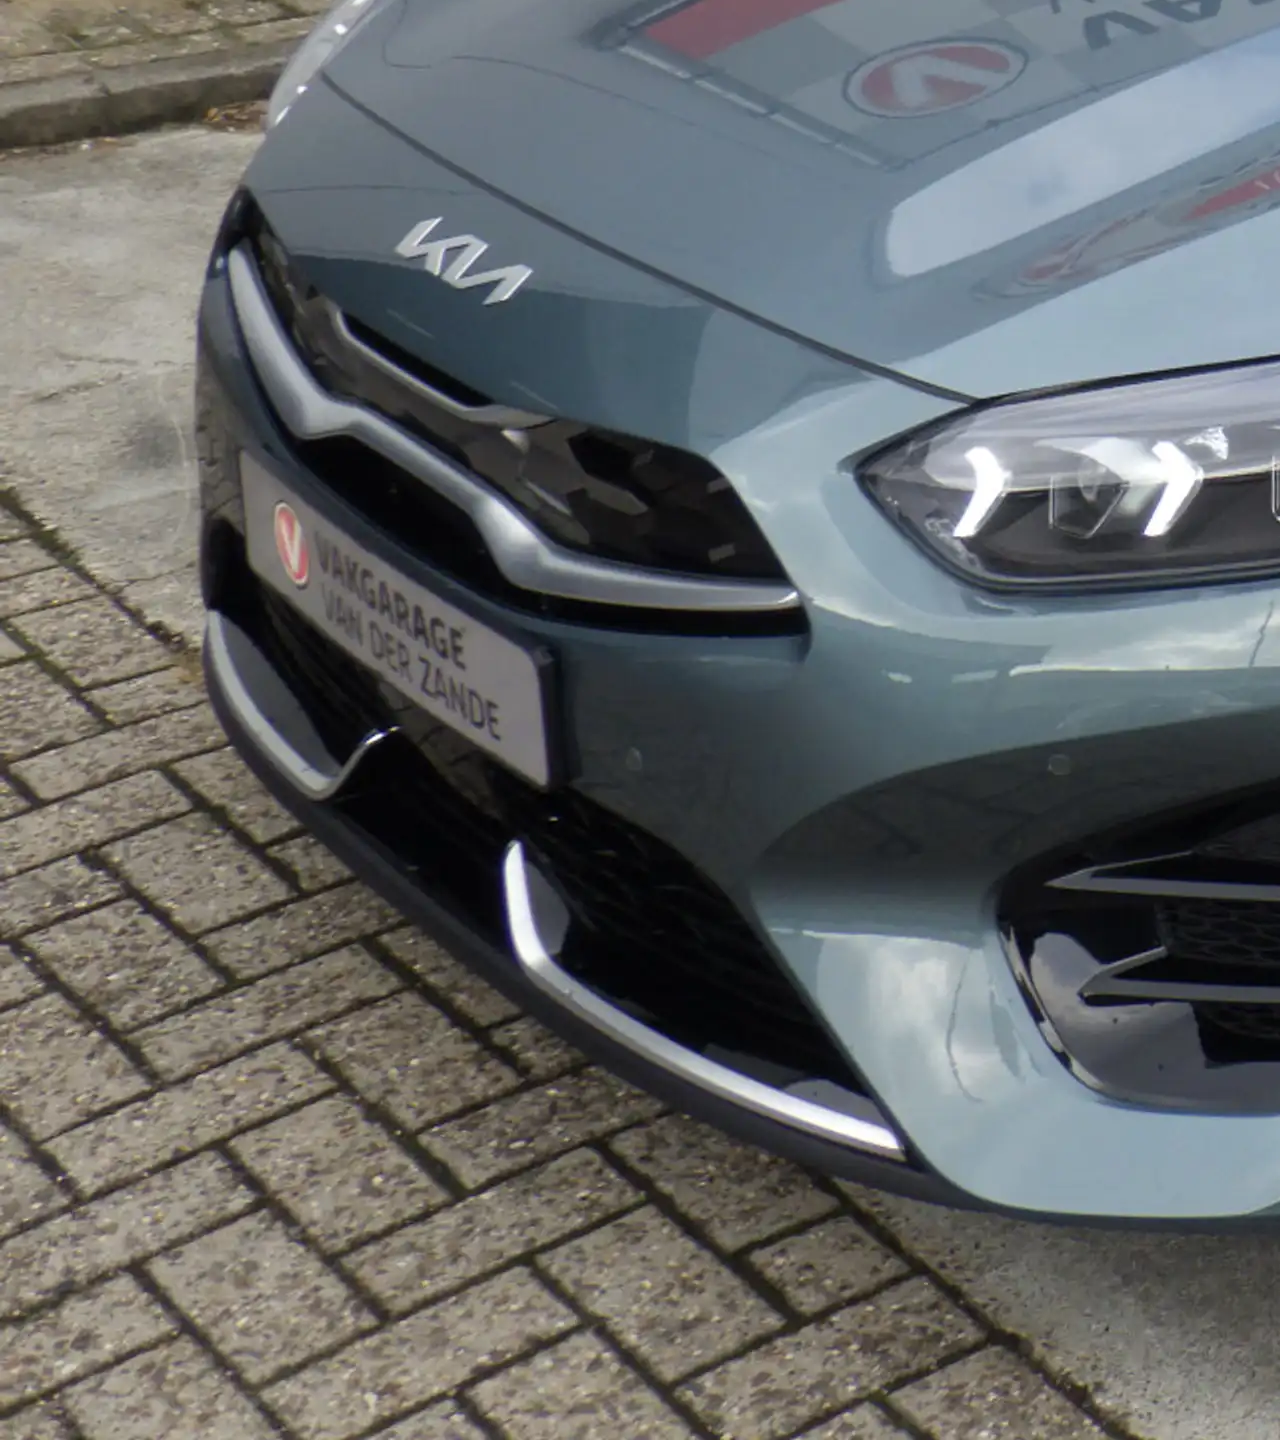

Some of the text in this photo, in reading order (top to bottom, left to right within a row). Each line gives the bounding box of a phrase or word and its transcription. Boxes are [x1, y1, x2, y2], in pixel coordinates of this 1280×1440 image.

[394, 216, 534, 306] KIA
[314, 530, 467, 671] VAKGARAGE
[321, 581, 502, 741] VAN DER ZANDE
